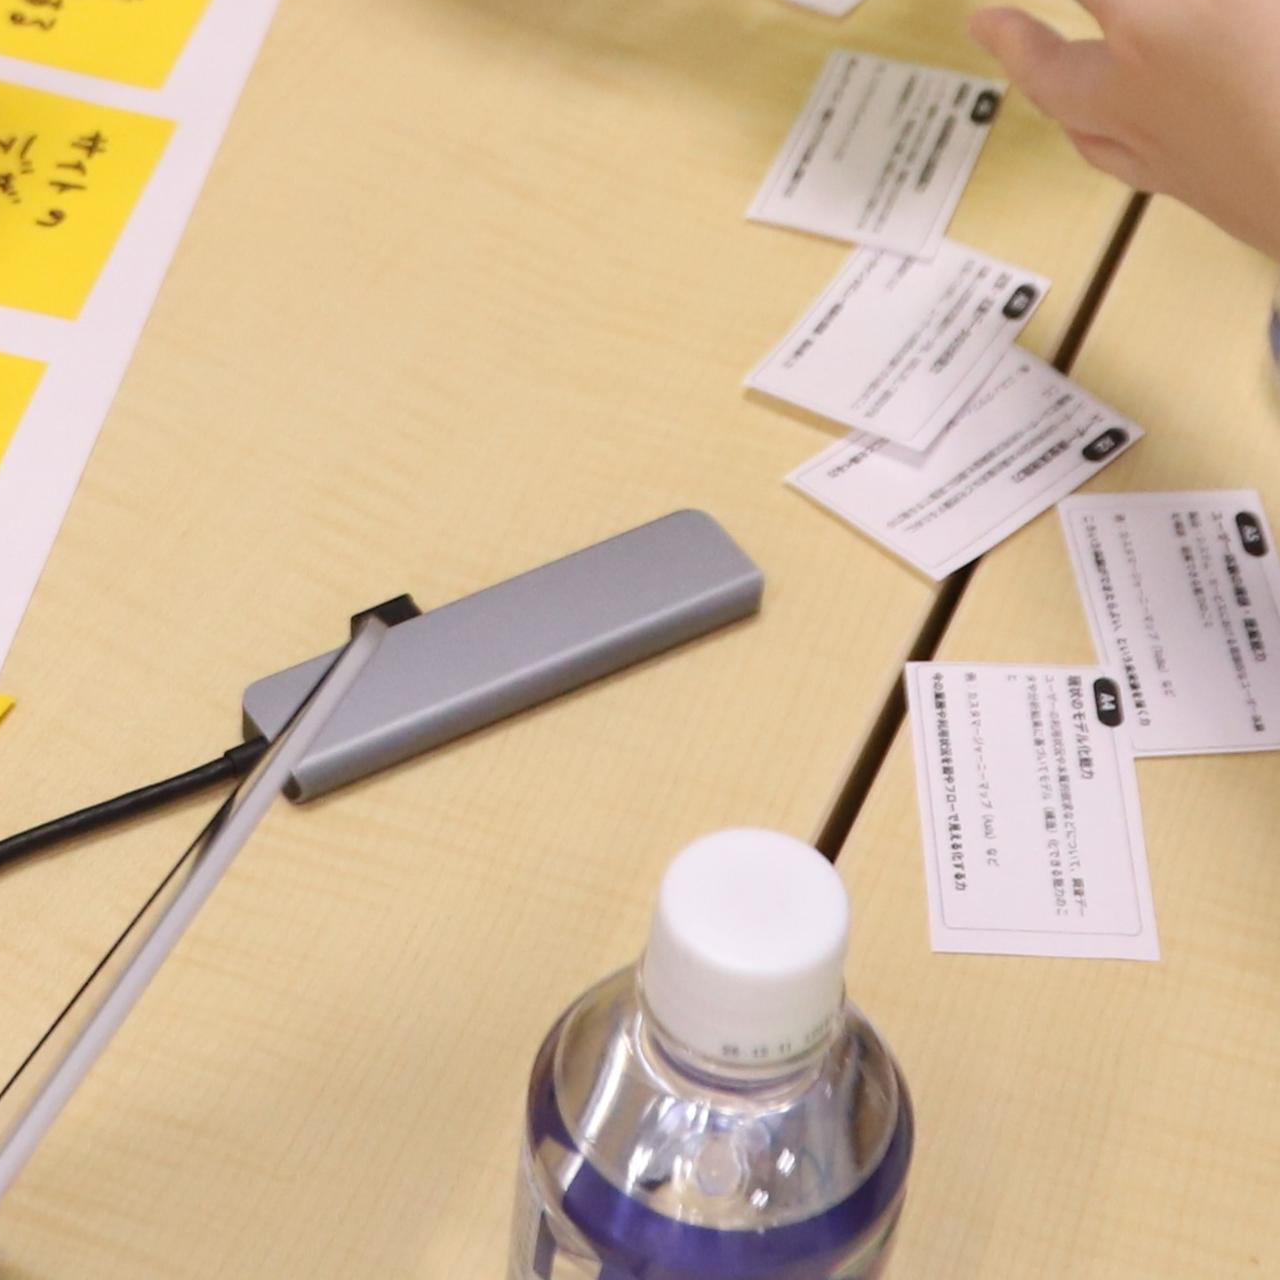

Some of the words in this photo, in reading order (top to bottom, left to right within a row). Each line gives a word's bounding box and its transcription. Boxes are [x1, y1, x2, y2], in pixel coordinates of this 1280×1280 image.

[35, 130, 109, 229] サイトの
[1097, 692, 1116, 711] A4
